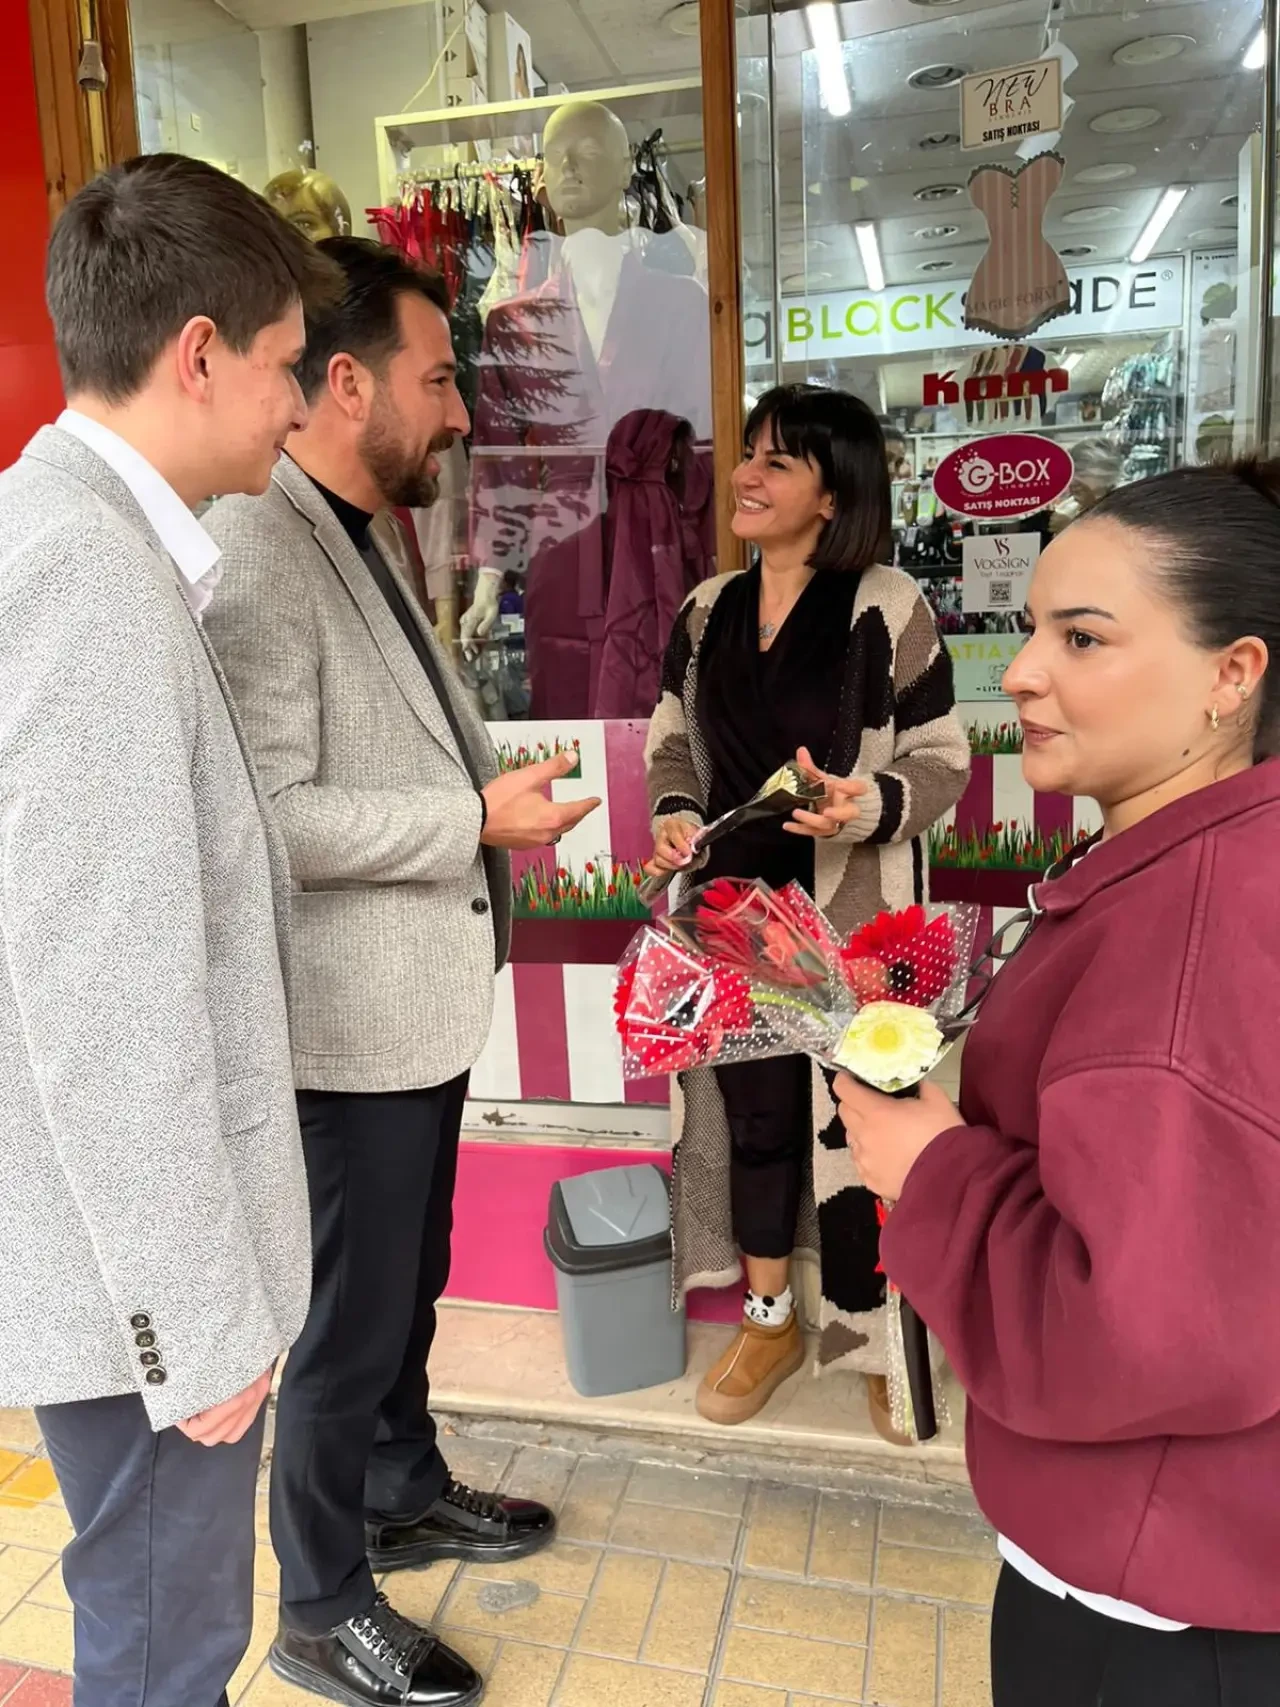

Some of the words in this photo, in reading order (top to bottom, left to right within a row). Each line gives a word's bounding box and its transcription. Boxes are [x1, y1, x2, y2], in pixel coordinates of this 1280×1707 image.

[974, 67, 1048, 107] NEW
[982, 128, 1005, 142] SATIŞ
[1006, 120, 1040, 137] NOKTASI
[966, 297, 1010, 315] MAGIC
[1016, 286, 1057, 307] FORM
[968, 457, 1051, 487] G-BOX
[963, 500, 993, 511] SATIŞ
[995, 496, 1040, 508] NOKTASI
